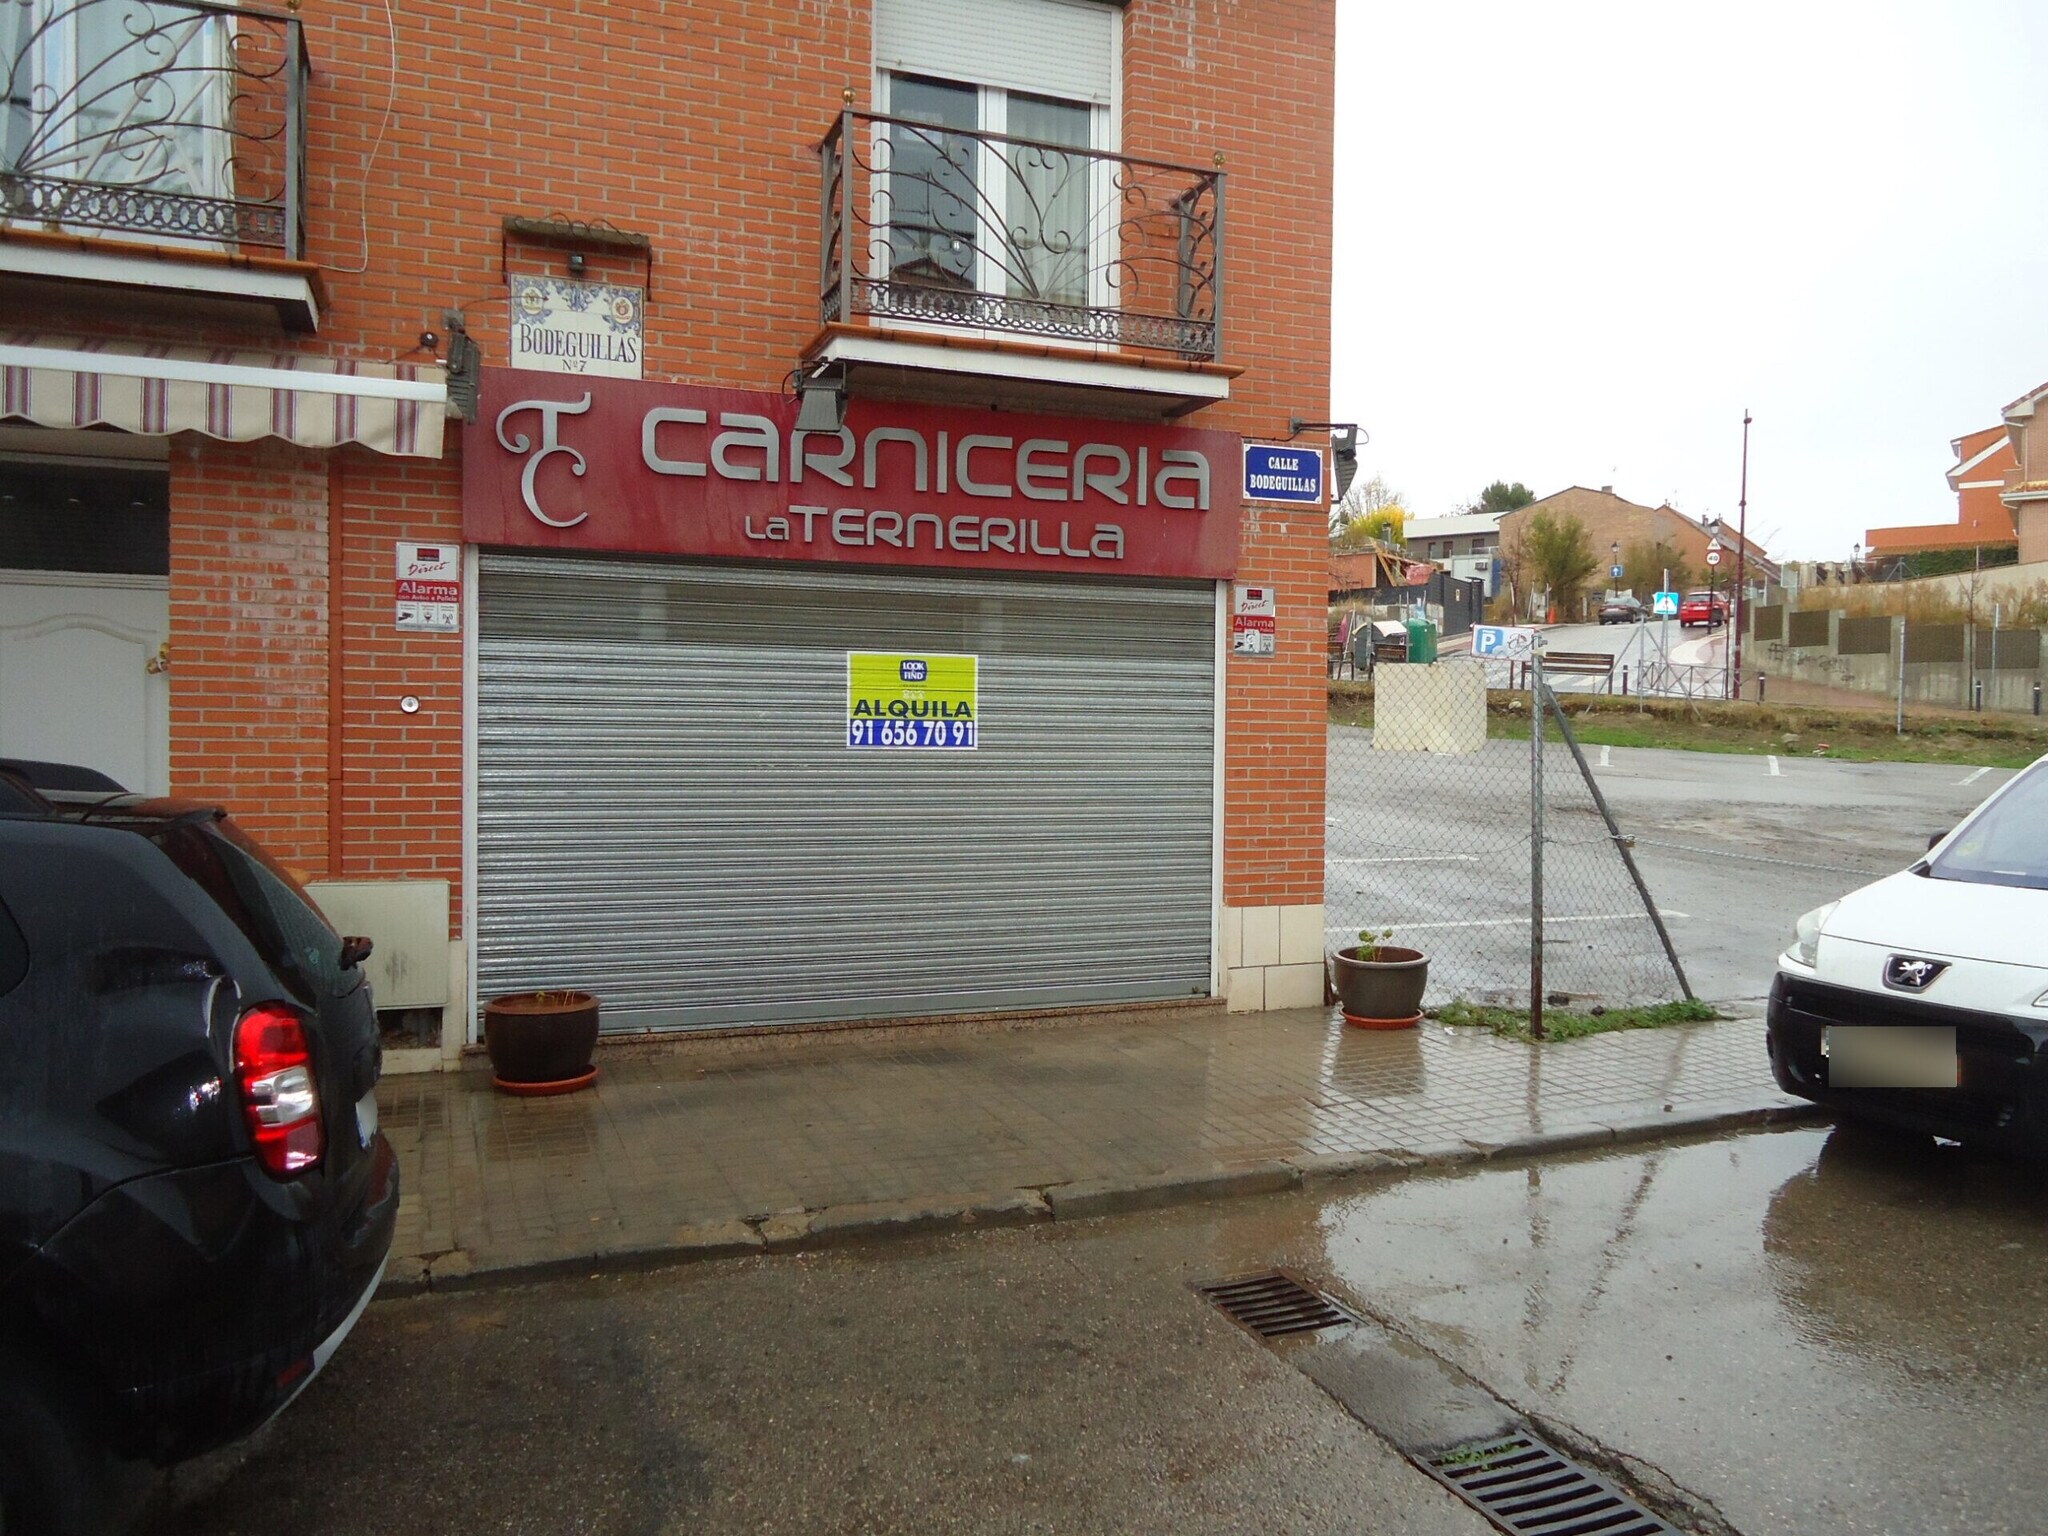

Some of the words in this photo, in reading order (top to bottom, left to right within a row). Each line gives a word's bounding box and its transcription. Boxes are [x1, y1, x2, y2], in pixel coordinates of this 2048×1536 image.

[519, 323, 637, 363] BODEGUILLAS
[1268, 456, 1299, 471] CALLE
[1250, 474, 1316, 493] BODEGUILLAS
[1708, 554, 1719, 562] 40
[399, 582, 458, 595] Alarma
[1235, 617, 1274, 627] Alarma
[1481, 632, 1496, 653] P
[902, 662, 925, 670] LOOK
[904, 671, 924, 680] FIND
[853, 699, 972, 718] ALQUILA
[852, 720, 873, 745] 91
[881, 720, 918, 745] 656
[922, 721, 947, 746] 70
[952, 721, 974, 746] 91
